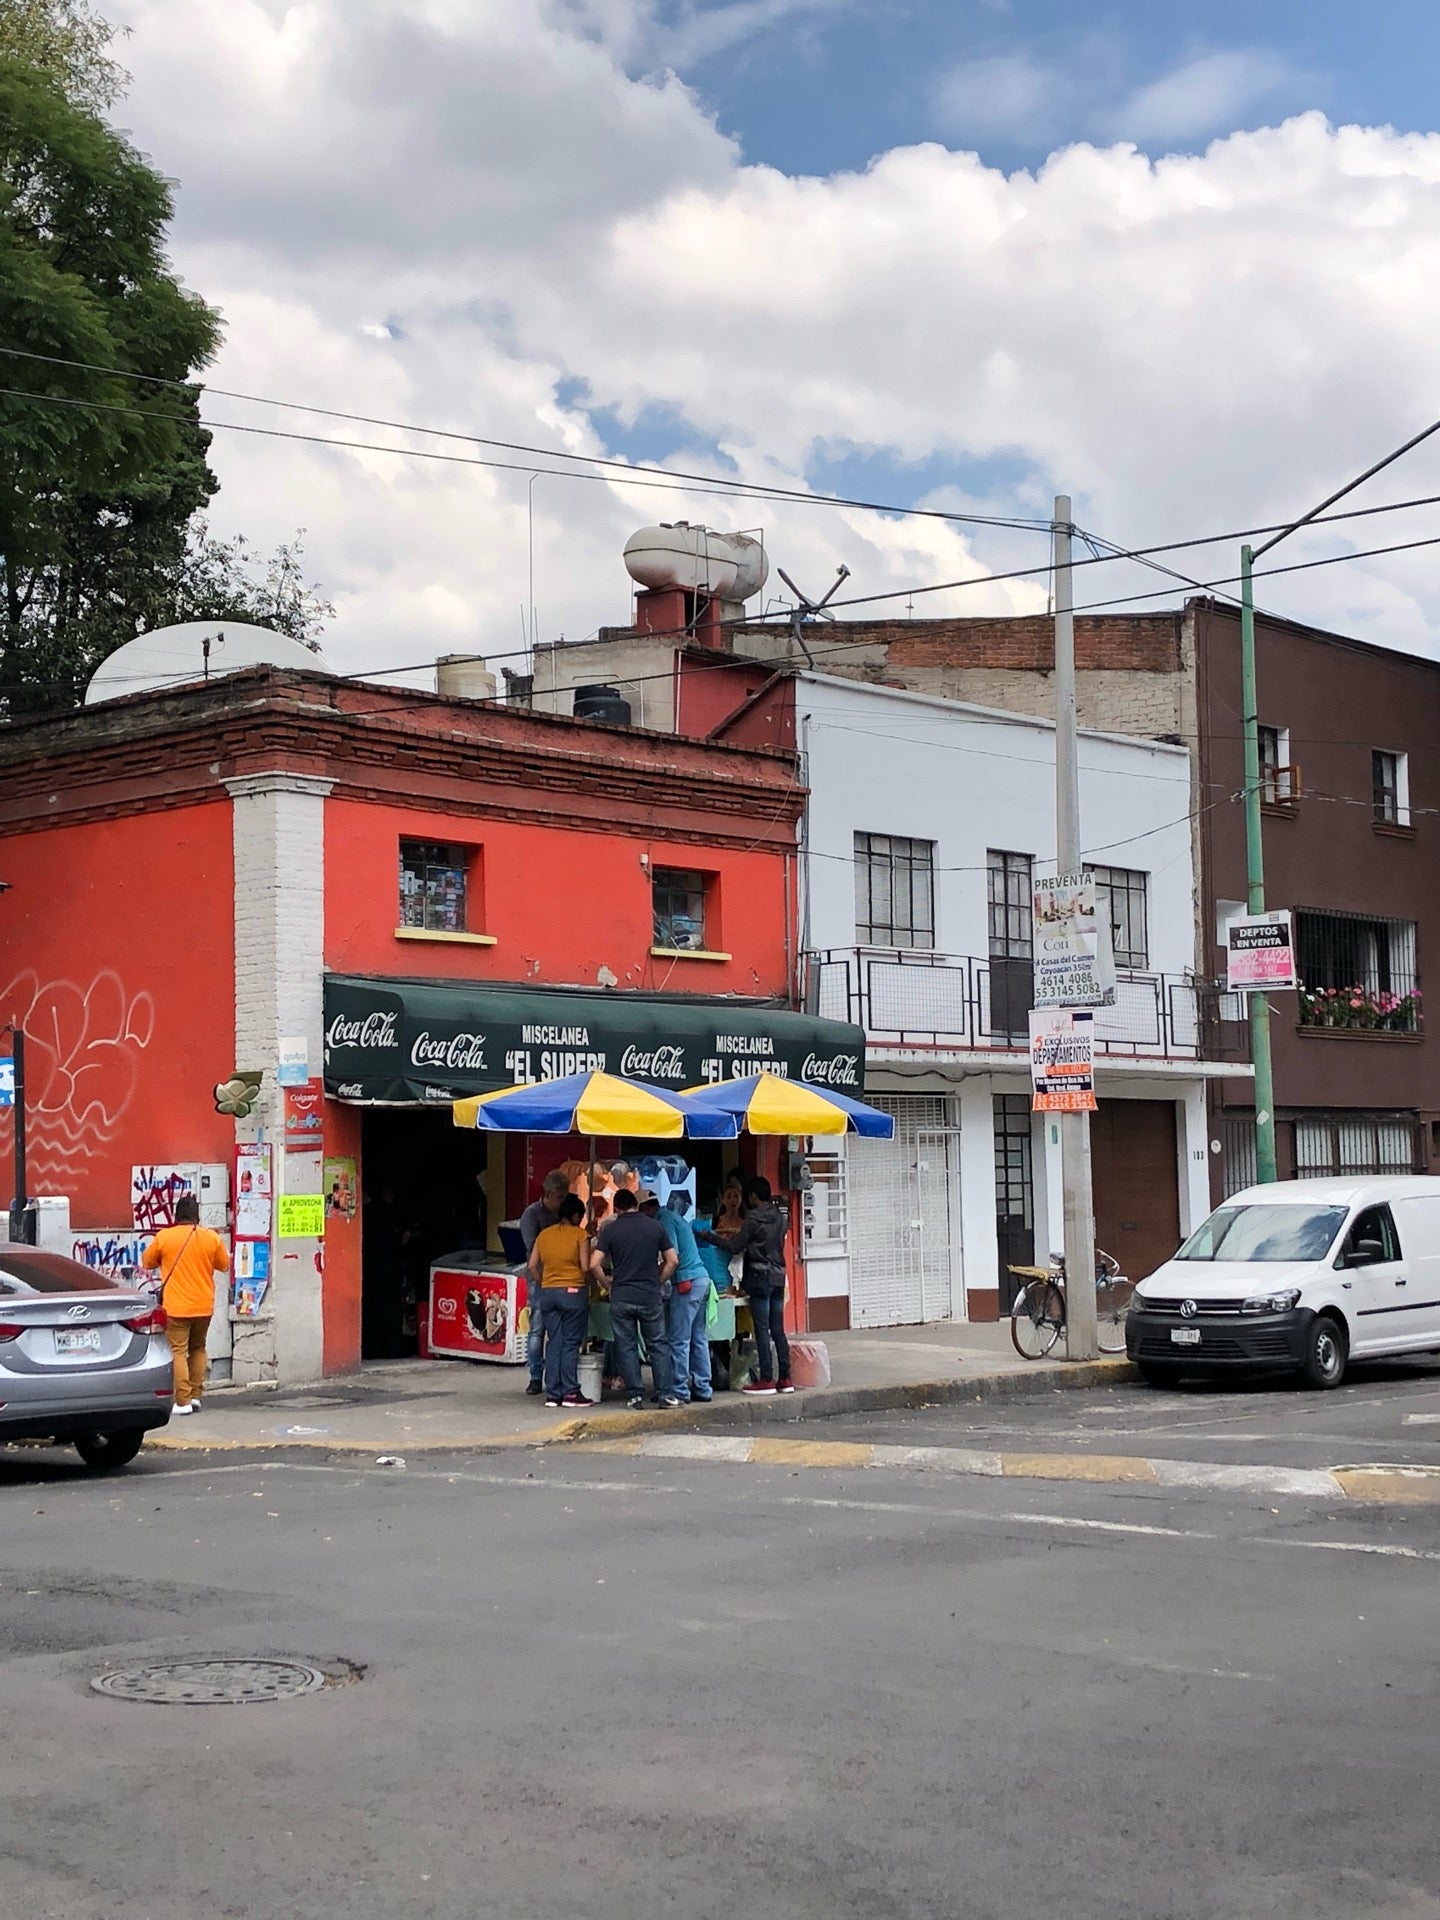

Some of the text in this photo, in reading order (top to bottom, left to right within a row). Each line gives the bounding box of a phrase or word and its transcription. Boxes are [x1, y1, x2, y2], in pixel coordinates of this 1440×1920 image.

[1034, 874, 1092, 891] PREVENTA
[1240, 927, 1278, 937] DEPTOS
[1237, 938, 1282, 948] EN VENTA
[1041, 958, 1060, 966] Casas
[1061, 955, 1071, 964] del
[1041, 972, 1093, 986] 4614 4086
[1036, 983, 1100, 998] 55 3145 5082
[329, 1012, 398, 1048] Coca-Cola
[522, 1025, 589, 1046] MISCELANEA
[411, 1032, 487, 1068] Coca-Cola
[716, 1035, 774, 1055] MISCELANEA
[1035, 1036, 1043, 1049] 5
[620, 1045, 686, 1078] Coca-Cola
[802, 1053, 859, 1085] Coca-Cola
[290, 1094, 318, 1103] Colgate
